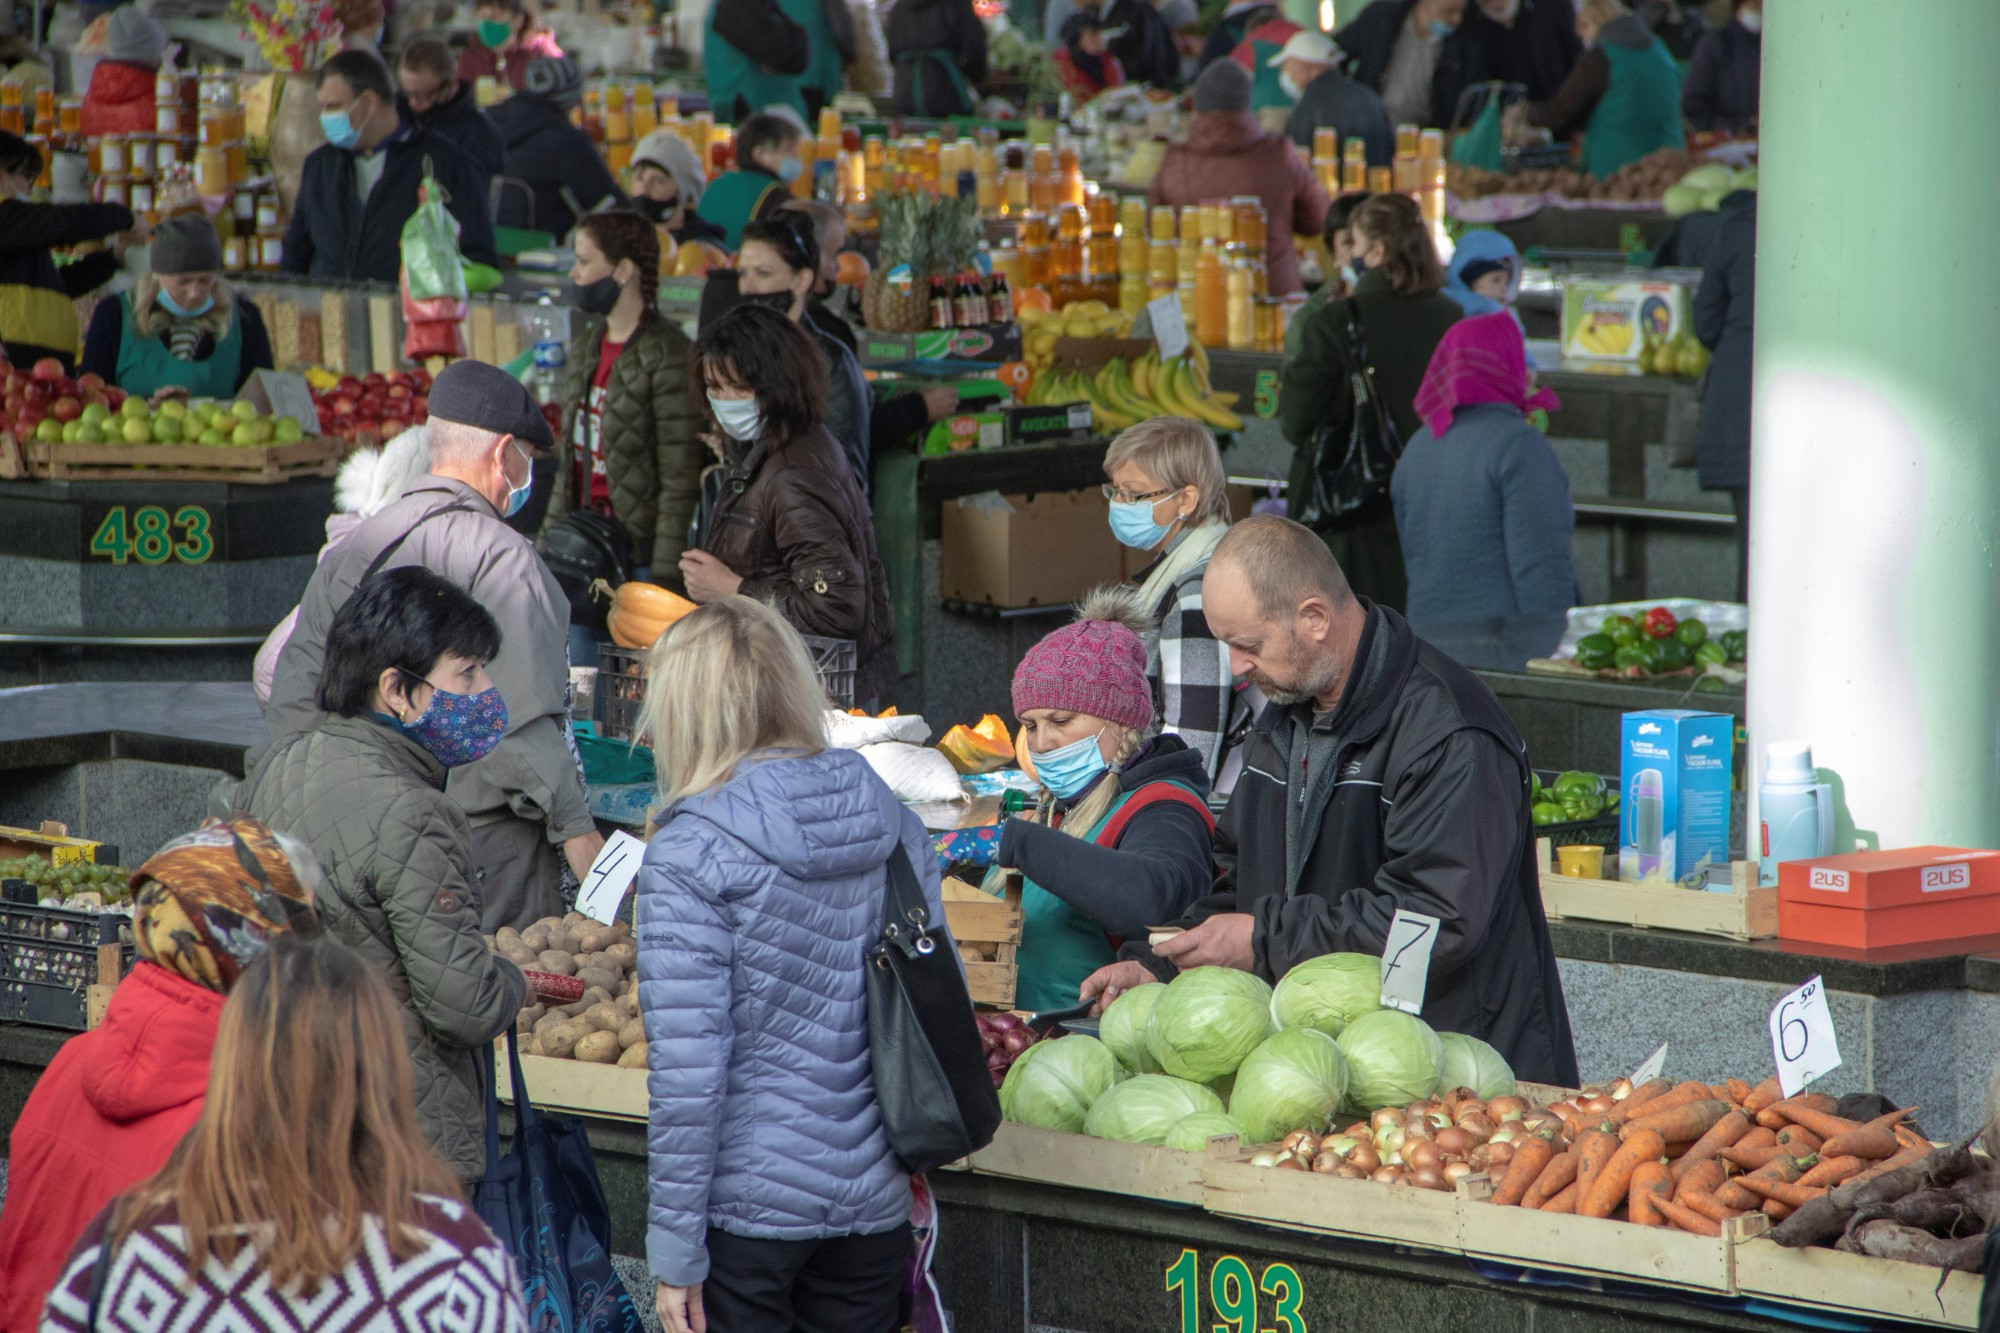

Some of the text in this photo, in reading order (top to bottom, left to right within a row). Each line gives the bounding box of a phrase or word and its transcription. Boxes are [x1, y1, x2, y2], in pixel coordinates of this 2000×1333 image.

[1254, 370, 1282, 419] 5
[91, 505, 214, 565] 483
[586, 840, 628, 903] 4
[1814, 872, 1845, 888] 2US
[1927, 868, 1964, 886] 2US
[1384, 918, 1431, 984] 7
[1779, 984, 1816, 1063] 6 50
[1166, 1248, 1307, 1333] 193
